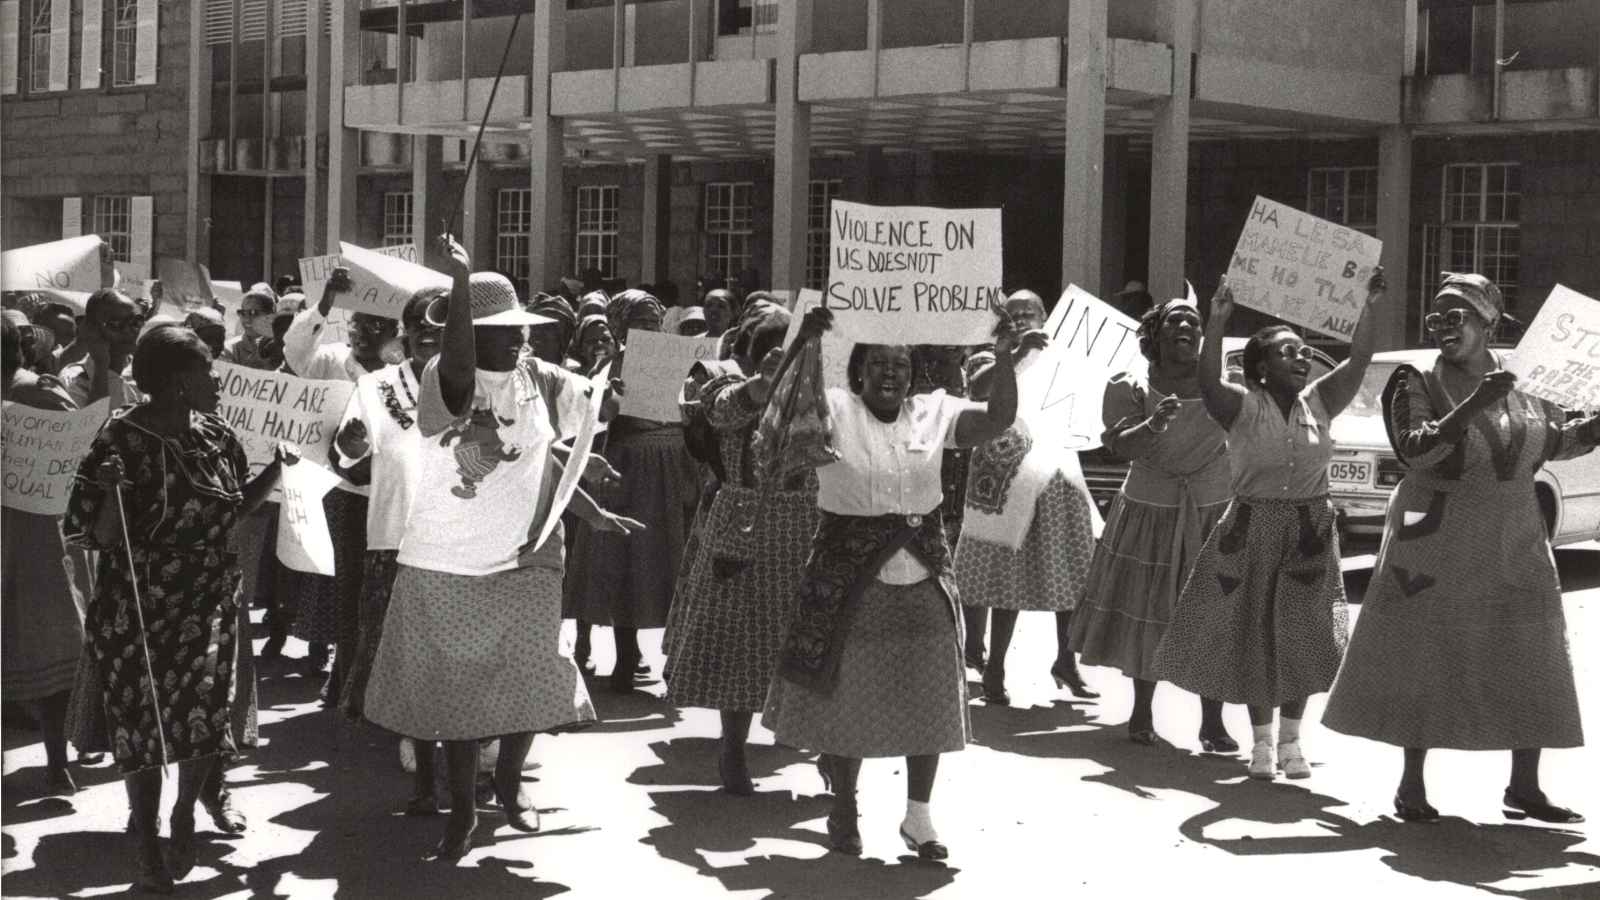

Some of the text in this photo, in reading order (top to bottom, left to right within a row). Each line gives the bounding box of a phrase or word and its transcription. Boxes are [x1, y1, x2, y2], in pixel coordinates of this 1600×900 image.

[1250, 202, 1279, 229] HA
[835, 209, 975, 251] VIOLENCE ON
[837, 246, 863, 271] US
[829, 281, 903, 313] SOLVE
[1271, 265, 1298, 288] HO
[1315, 277, 1359, 309] TLA
[293, 386, 329, 413] ARE
[261, 410, 323, 444] HALVES
[1330, 463, 1366, 480] 0595
[4, 472, 56, 499] QUAL
